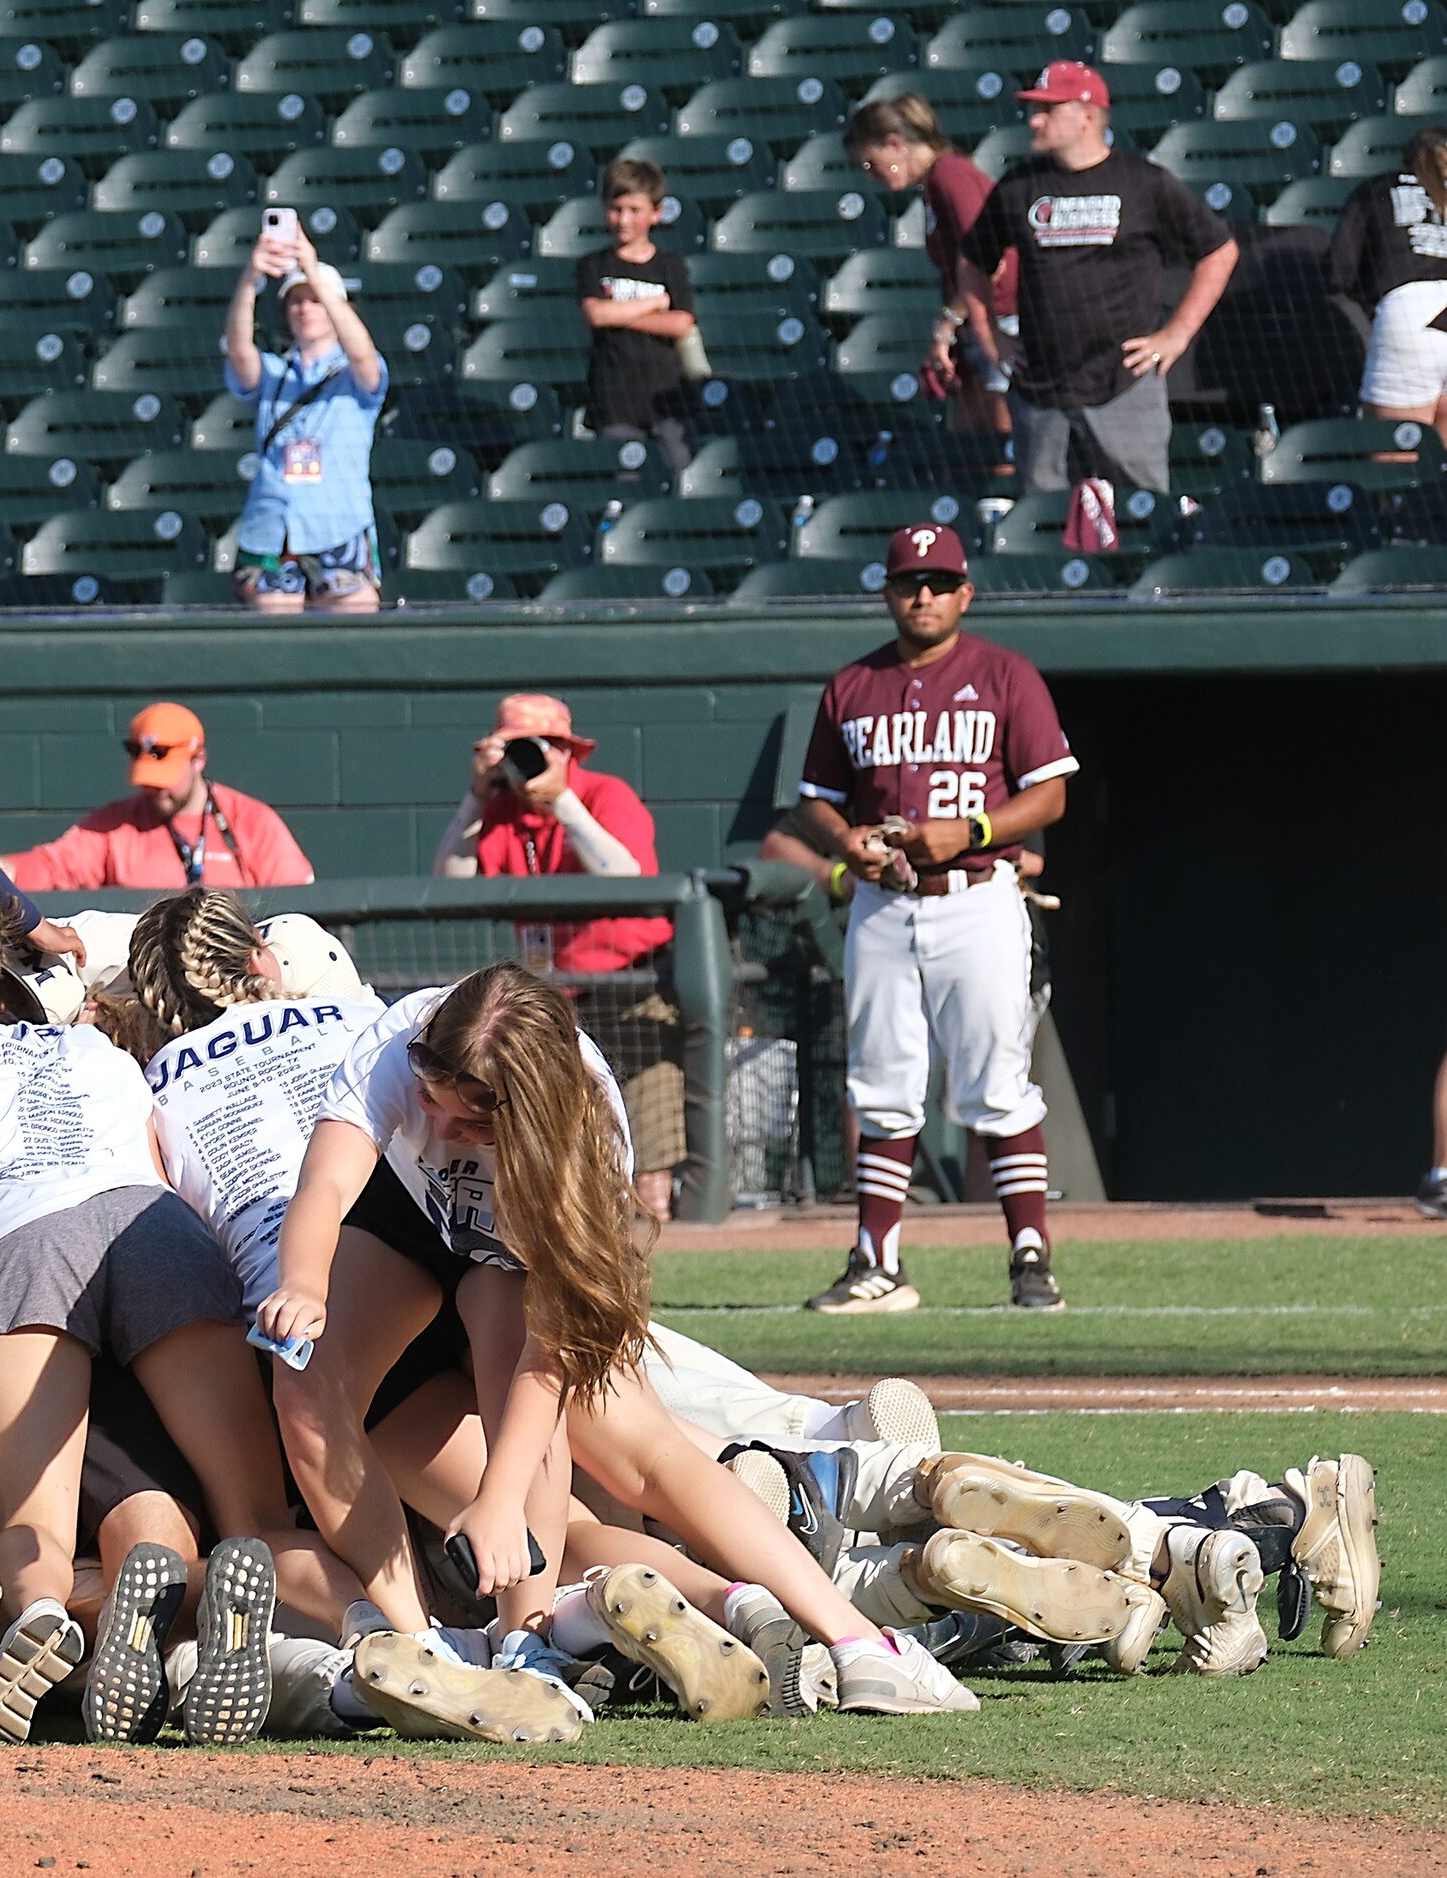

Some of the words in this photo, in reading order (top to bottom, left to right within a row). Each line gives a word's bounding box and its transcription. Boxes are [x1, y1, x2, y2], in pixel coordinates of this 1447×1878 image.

[911, 529, 936, 557] P
[841, 710, 996, 769] PEARLAND
[928, 770, 987, 819] 26
[152, 1004, 344, 1095] JAGUAR
[199, 1079, 223, 1093] 2023
[225, 1066, 252, 1082] STATE
[252, 1042, 316, 1070] TOURNAMENT
[223, 1075, 256, 1090] ROUND
[226, 1085, 251, 1098] JUNE
[277, 1063, 301, 1077] 2023
